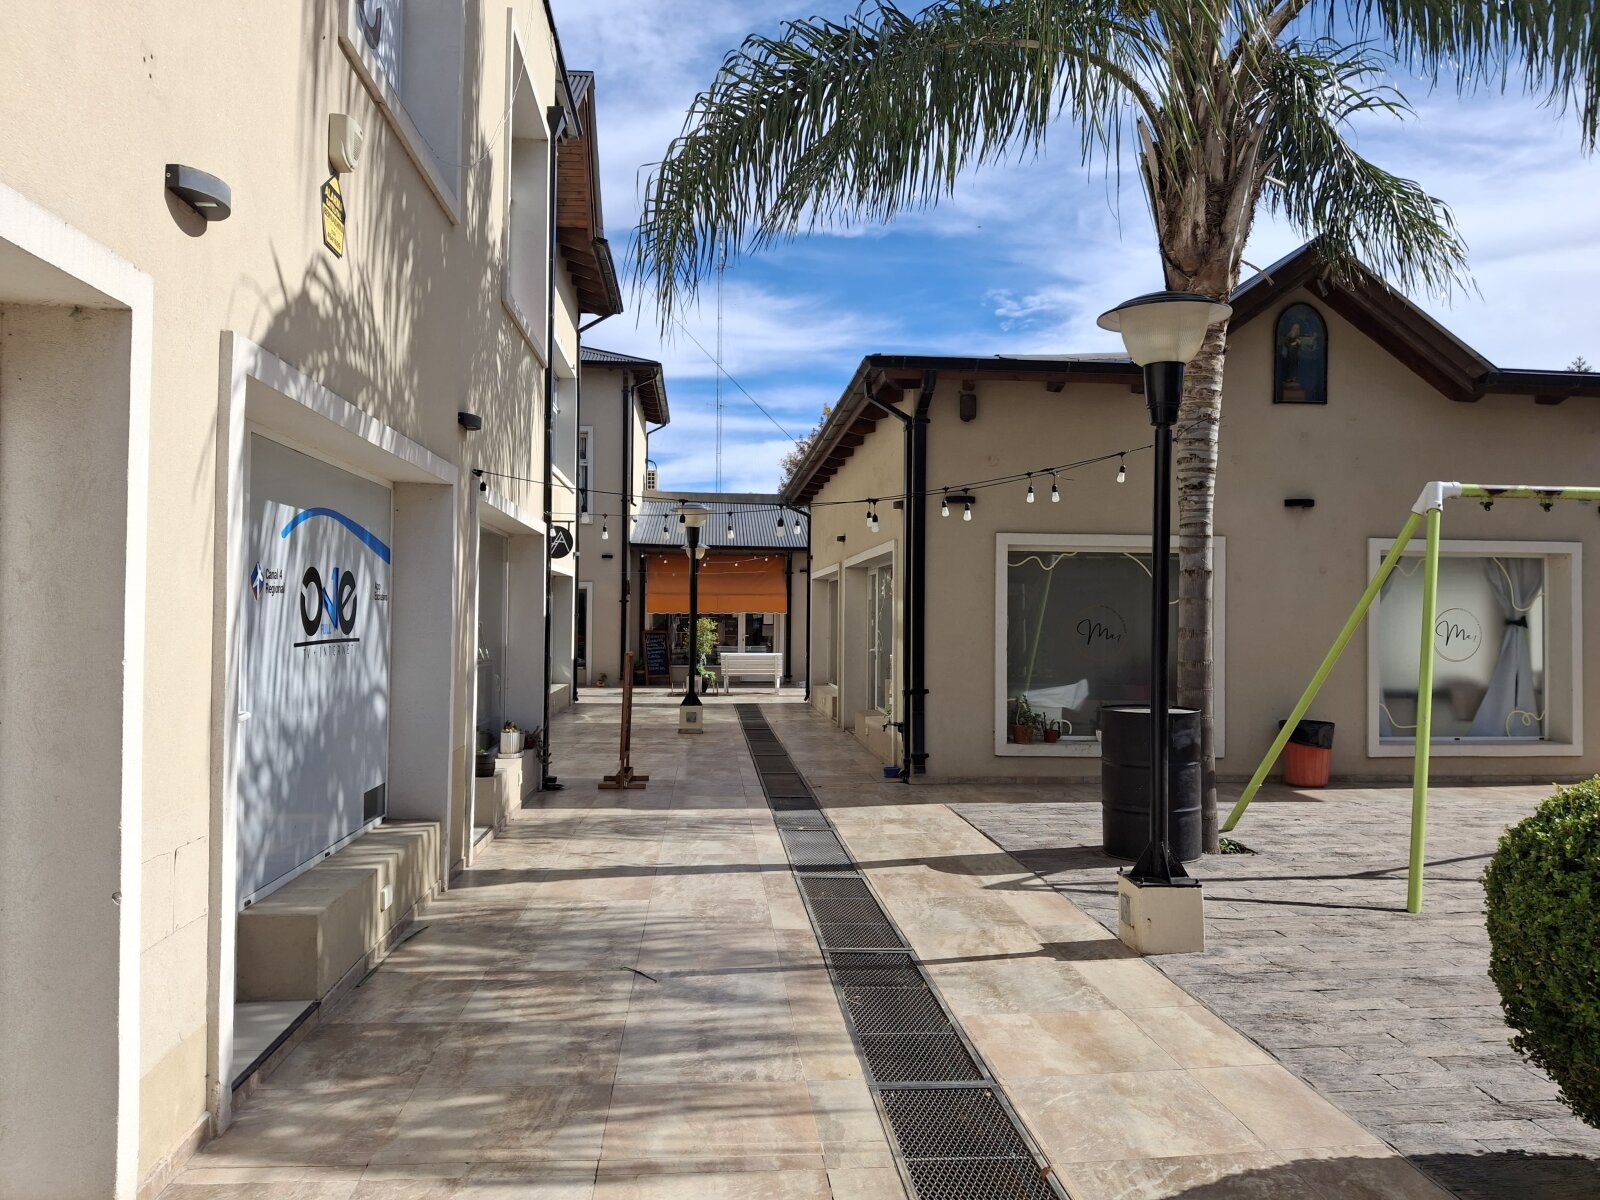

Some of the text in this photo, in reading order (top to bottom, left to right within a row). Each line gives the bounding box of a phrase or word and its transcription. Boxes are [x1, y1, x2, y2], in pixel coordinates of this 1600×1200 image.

[265, 568, 279, 580] Canal
[265, 582, 286, 596] Regional
[320, 624, 332, 635] FULL
